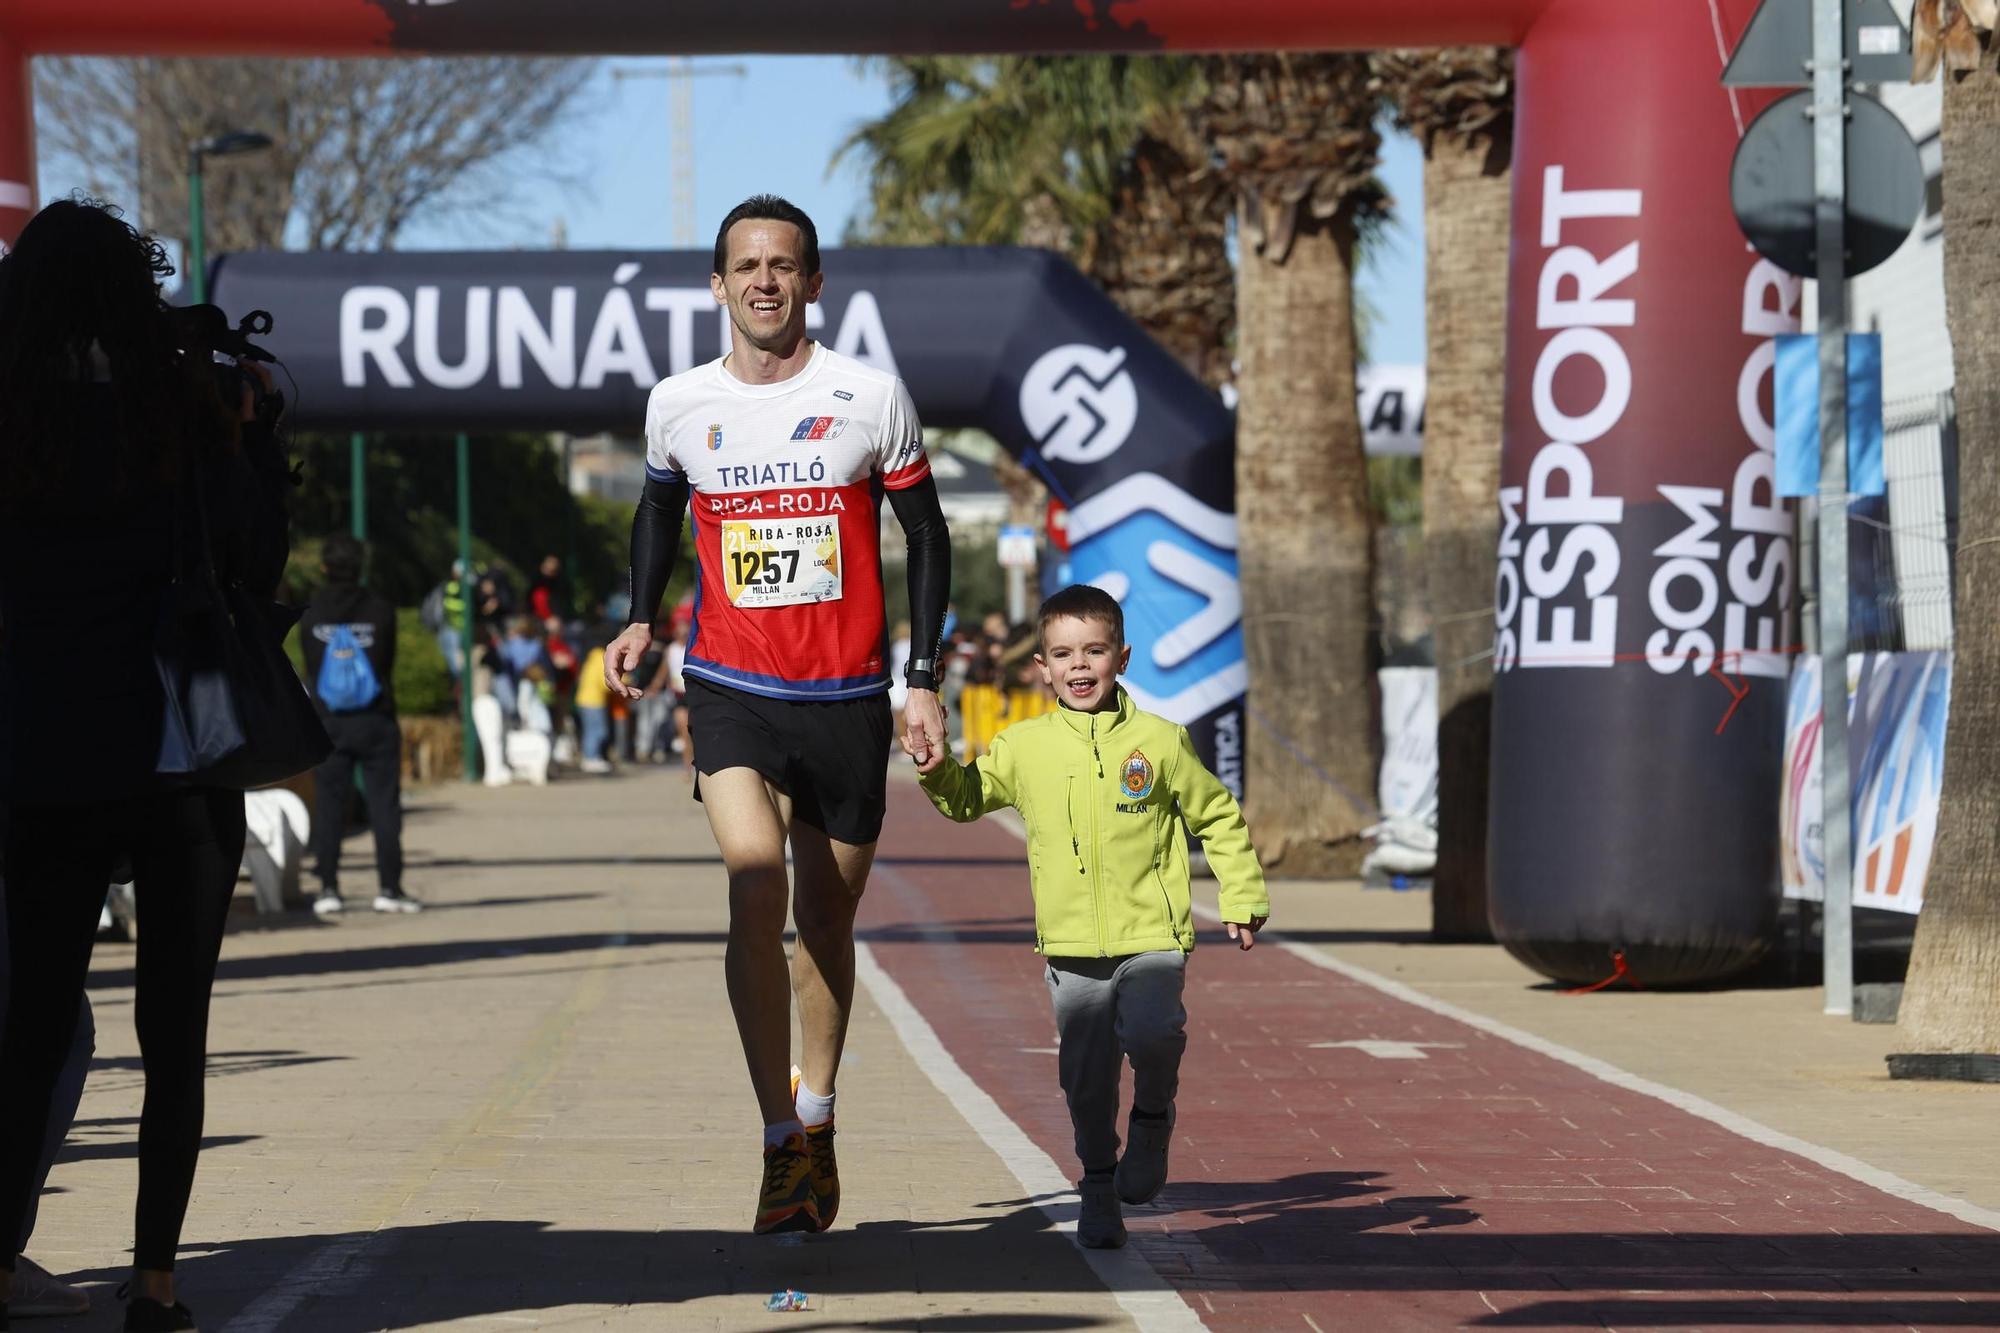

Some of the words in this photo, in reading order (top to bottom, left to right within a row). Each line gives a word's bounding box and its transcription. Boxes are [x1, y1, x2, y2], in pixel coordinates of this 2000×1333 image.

[339, 262, 900, 389] RUNÁTA
[1519, 164, 1642, 667] ESPORT
[717, 455, 825, 488] TRIATLÓ
[1722, 241, 1801, 678] ESPOR
[711, 491, 846, 516] RIBA-ROJA
[731, 550, 800, 586] 1257
[752, 585, 780, 594] MILLAN
[1645, 484, 1724, 676] SOM
